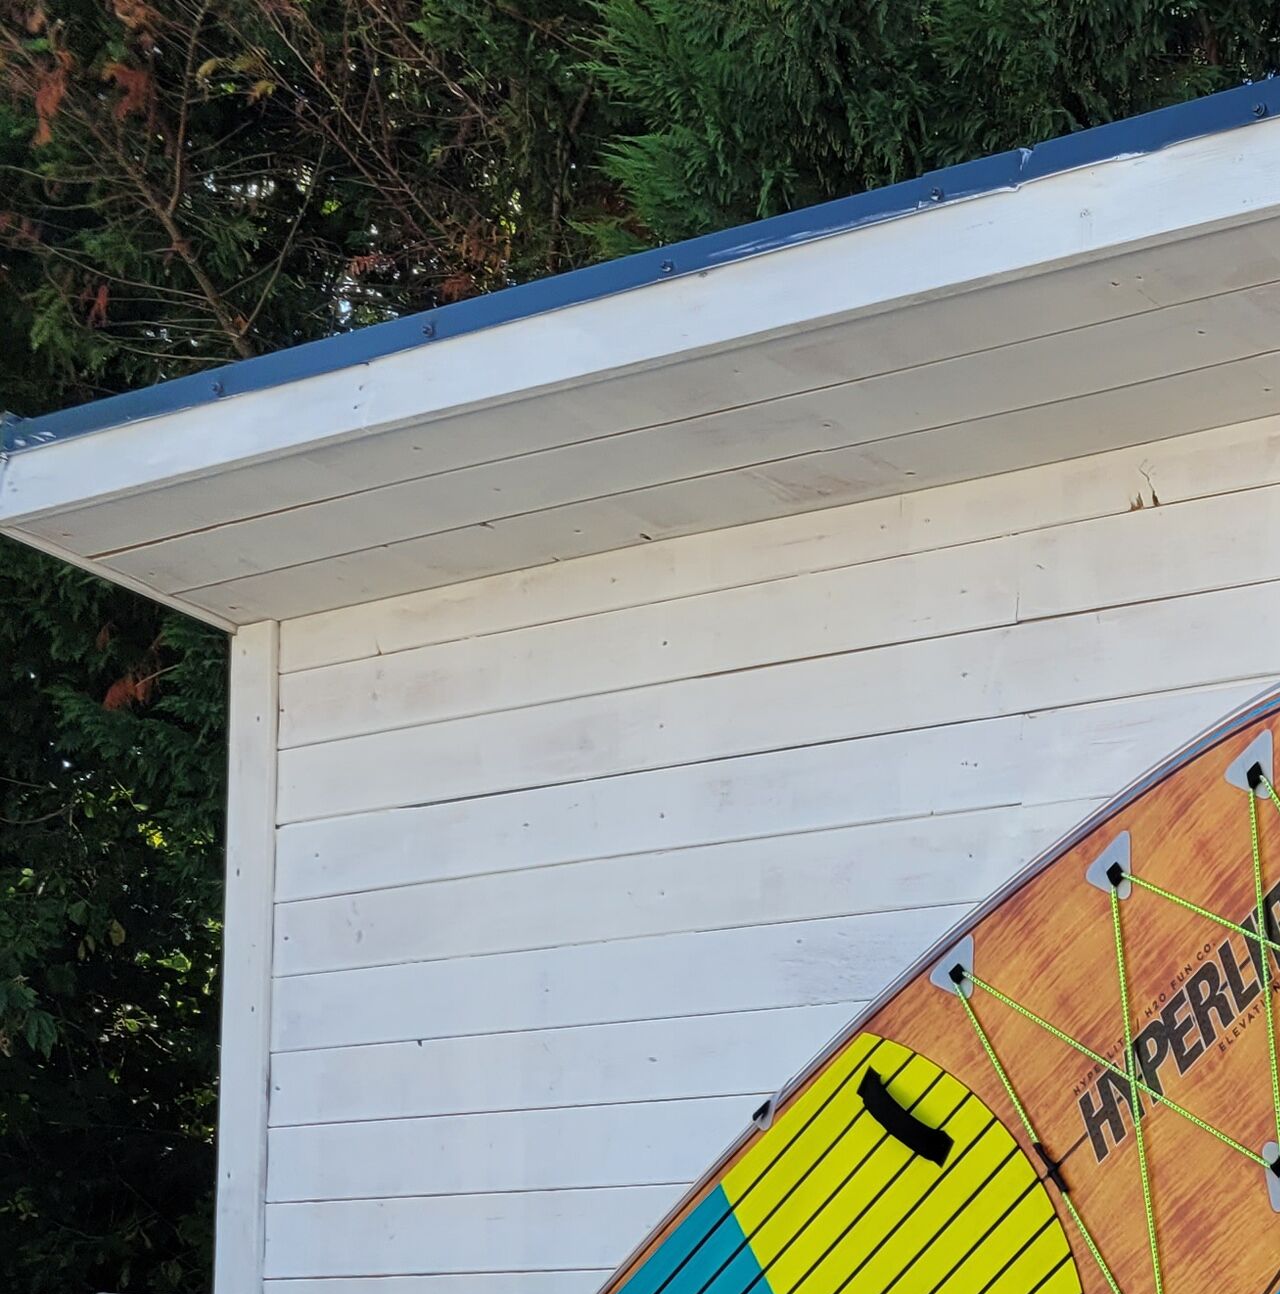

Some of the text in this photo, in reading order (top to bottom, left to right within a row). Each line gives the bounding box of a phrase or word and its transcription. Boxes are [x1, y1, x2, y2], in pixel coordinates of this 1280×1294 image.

[1144, 993, 1167, 1017] H2O
[1170, 964, 1193, 990] FUN
[1196, 942, 1217, 962] CO.
